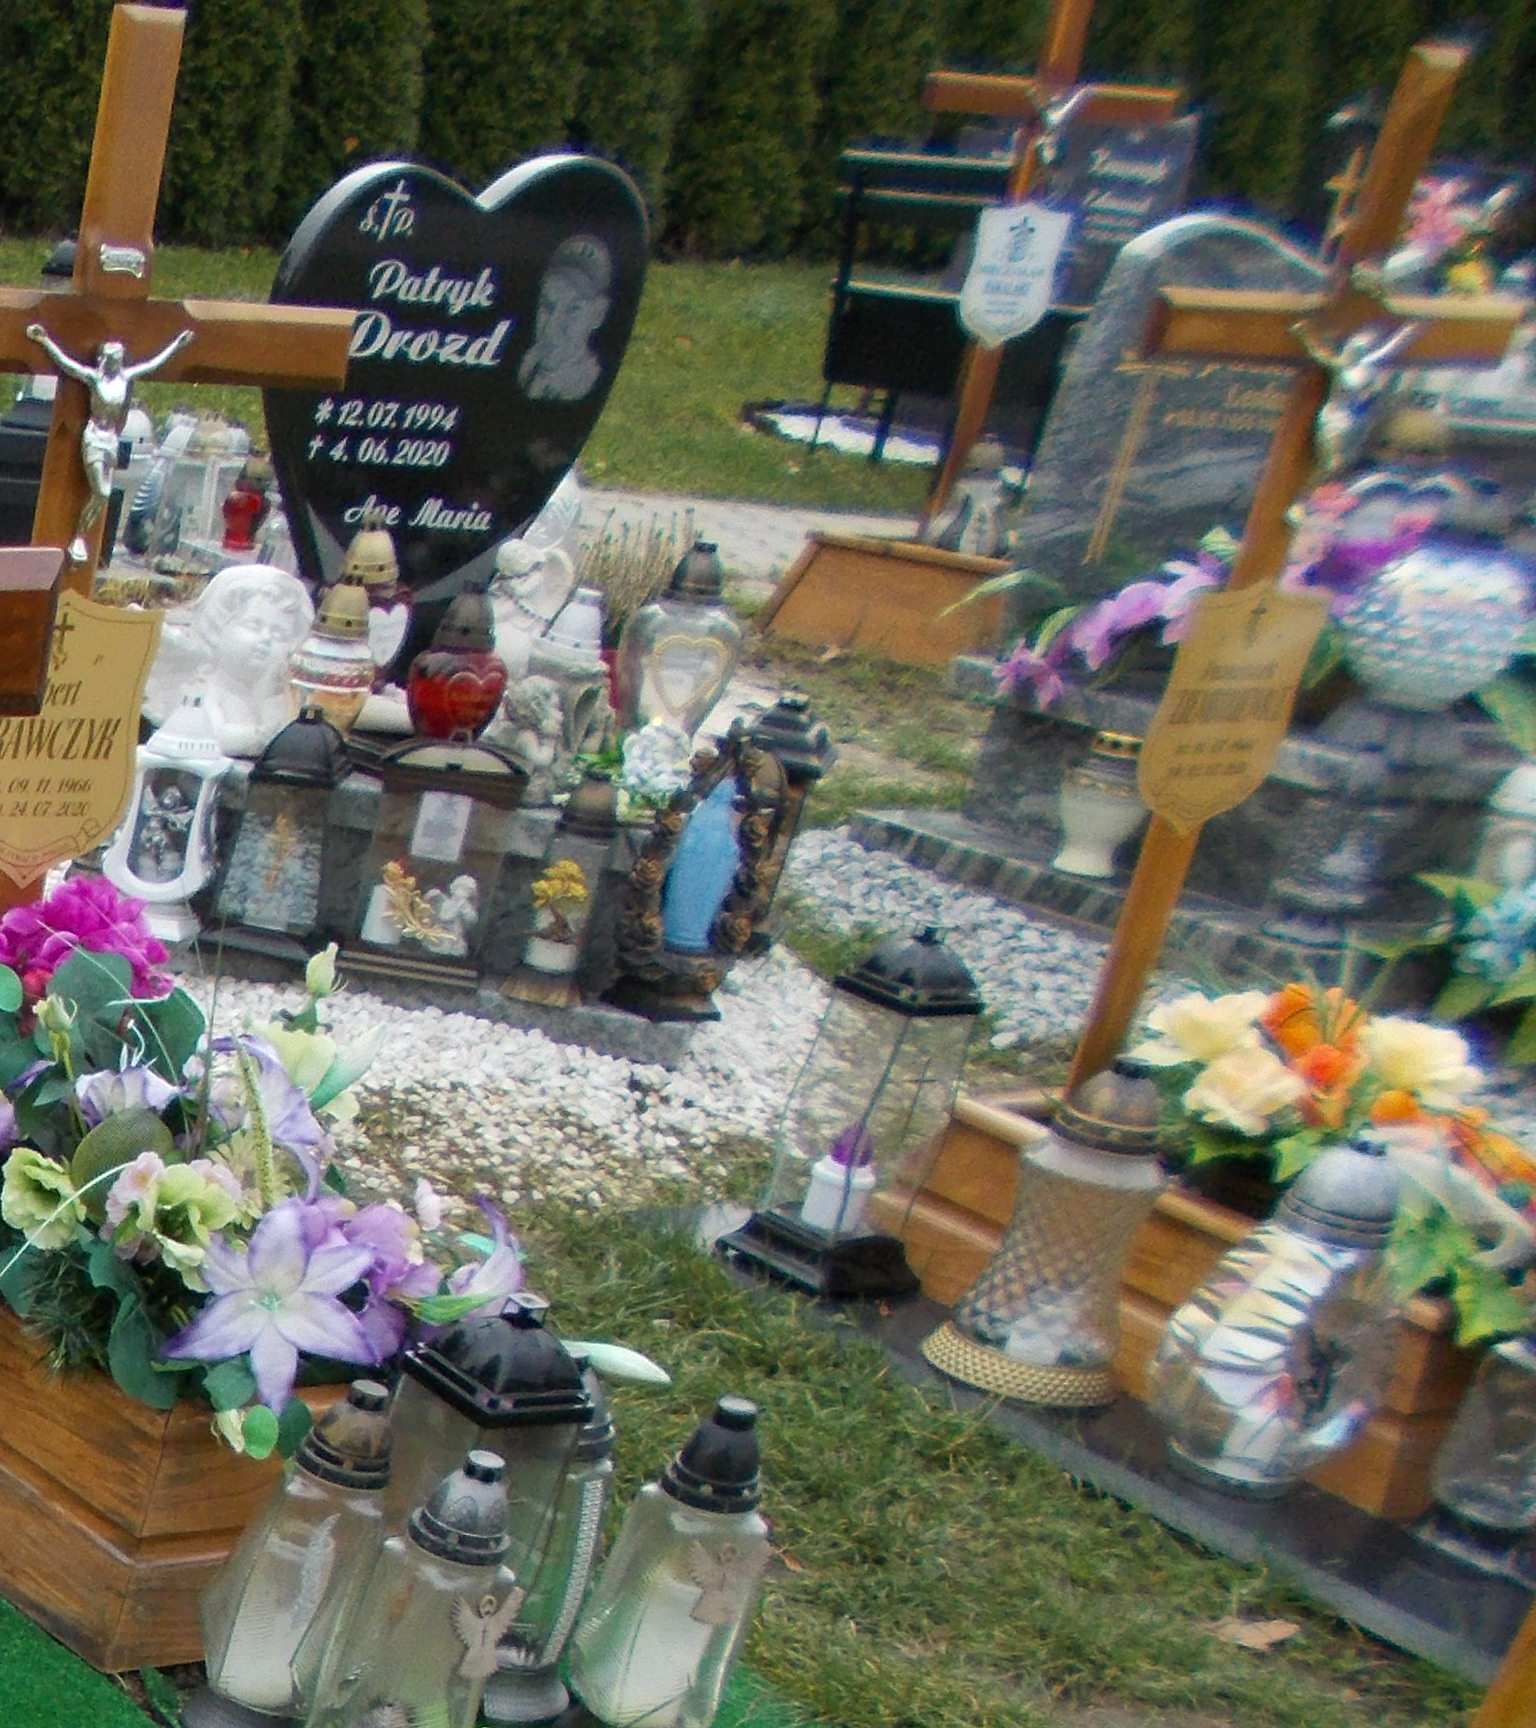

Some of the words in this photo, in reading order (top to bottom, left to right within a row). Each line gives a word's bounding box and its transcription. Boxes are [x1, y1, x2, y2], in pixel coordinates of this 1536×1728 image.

[369, 258, 496, 316] Patryk
[347, 310, 512, 366] Drozd
[407, 496, 494, 531] Maria
[55, 801, 92, 818] 2020
